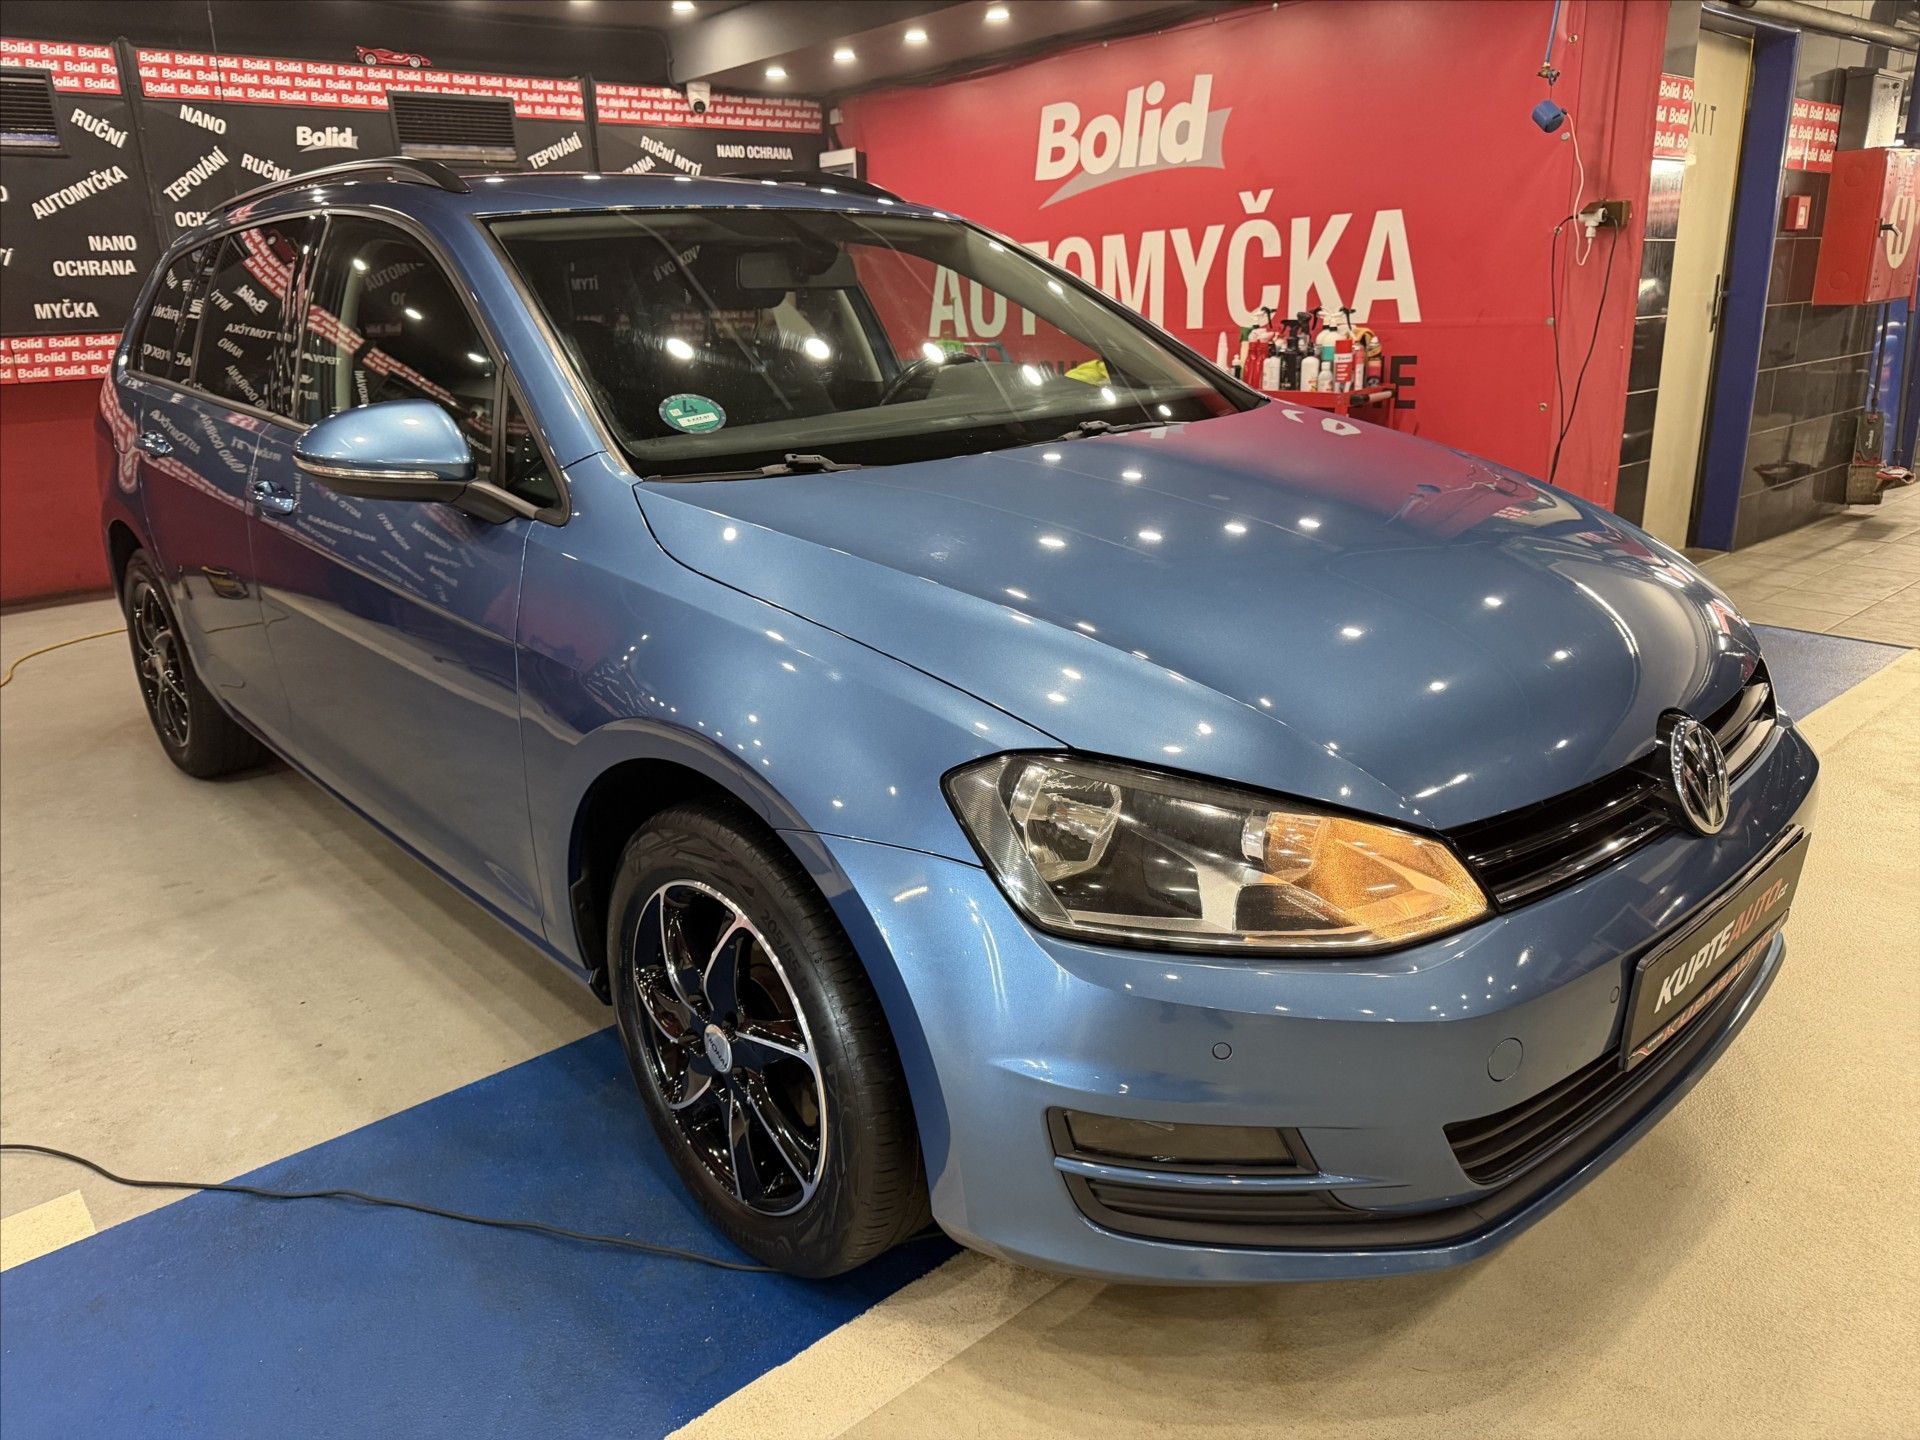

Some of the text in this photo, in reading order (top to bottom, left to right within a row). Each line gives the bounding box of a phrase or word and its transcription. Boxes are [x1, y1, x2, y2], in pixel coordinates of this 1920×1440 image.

[0, 41, 110, 58] Bolid Bolid Bolid
[25, 58, 58, 70] Bolid
[64, 61, 96, 73] Bolid
[140, 51, 578, 92] Bolid Bolid Bolid Bolid Bolid Bolid Bolid Bolid Bolid Bolid Bolid Bolid Bolid Bolid Bolid
[84, 77, 115, 89] Bolid
[162, 68, 191, 80] Bolid
[197, 71, 226, 81] Bolid
[230, 73, 258, 84] Bolid
[263, 75, 290, 86] Bolid
[295, 77, 321, 88] Bolid
[326, 80, 351, 90] Bolid
[356, 81, 381, 92] Bolid
[522, 92, 544, 102] Bolid
[547, 94, 569, 104] Bolid
[1659, 80, 1680, 99] Bolid
[146, 82, 175, 93] Bolid
[181, 84, 209, 95] Bolid
[215, 86, 243, 97] Bolid
[248, 88, 275, 99] Bolid
[280, 90, 306, 101] Bolid
[311, 92, 337, 103] Bolid
[342, 94, 367, 105] Bolid
[180, 104, 226, 135] NANO
[1669, 107, 1689, 125] Bolid
[70, 108, 129, 148] RUČNÍ
[296, 126, 353, 147] Bolid
[1035, 74, 1213, 181] Bolid
[1654, 131, 1675, 148] Bolid
[527, 131, 583, 170] TEPOVÁNÍ
[640, 135, 703, 176] RUČNÍ MYTÍ
[716, 144, 793, 160] NANO OCHRANA
[163, 145, 230, 203] TEPOVÁNÍ
[241, 153, 293, 182] RUČNÍ
[31, 165, 129, 220] AUTOMYČKA
[88, 235, 138, 251] NANO
[52, 260, 138, 277] OCHRANA
[33, 298, 100, 320] MYČKA
[11, 335, 116, 350] Bolid Bolid Bolid
[35, 352, 66, 363] Bolid
[72, 350, 103, 361] Bolid
[18, 367, 49, 379] Bolid
[55, 365, 86, 376] Bolid
[682, 399, 698, 414] 4
